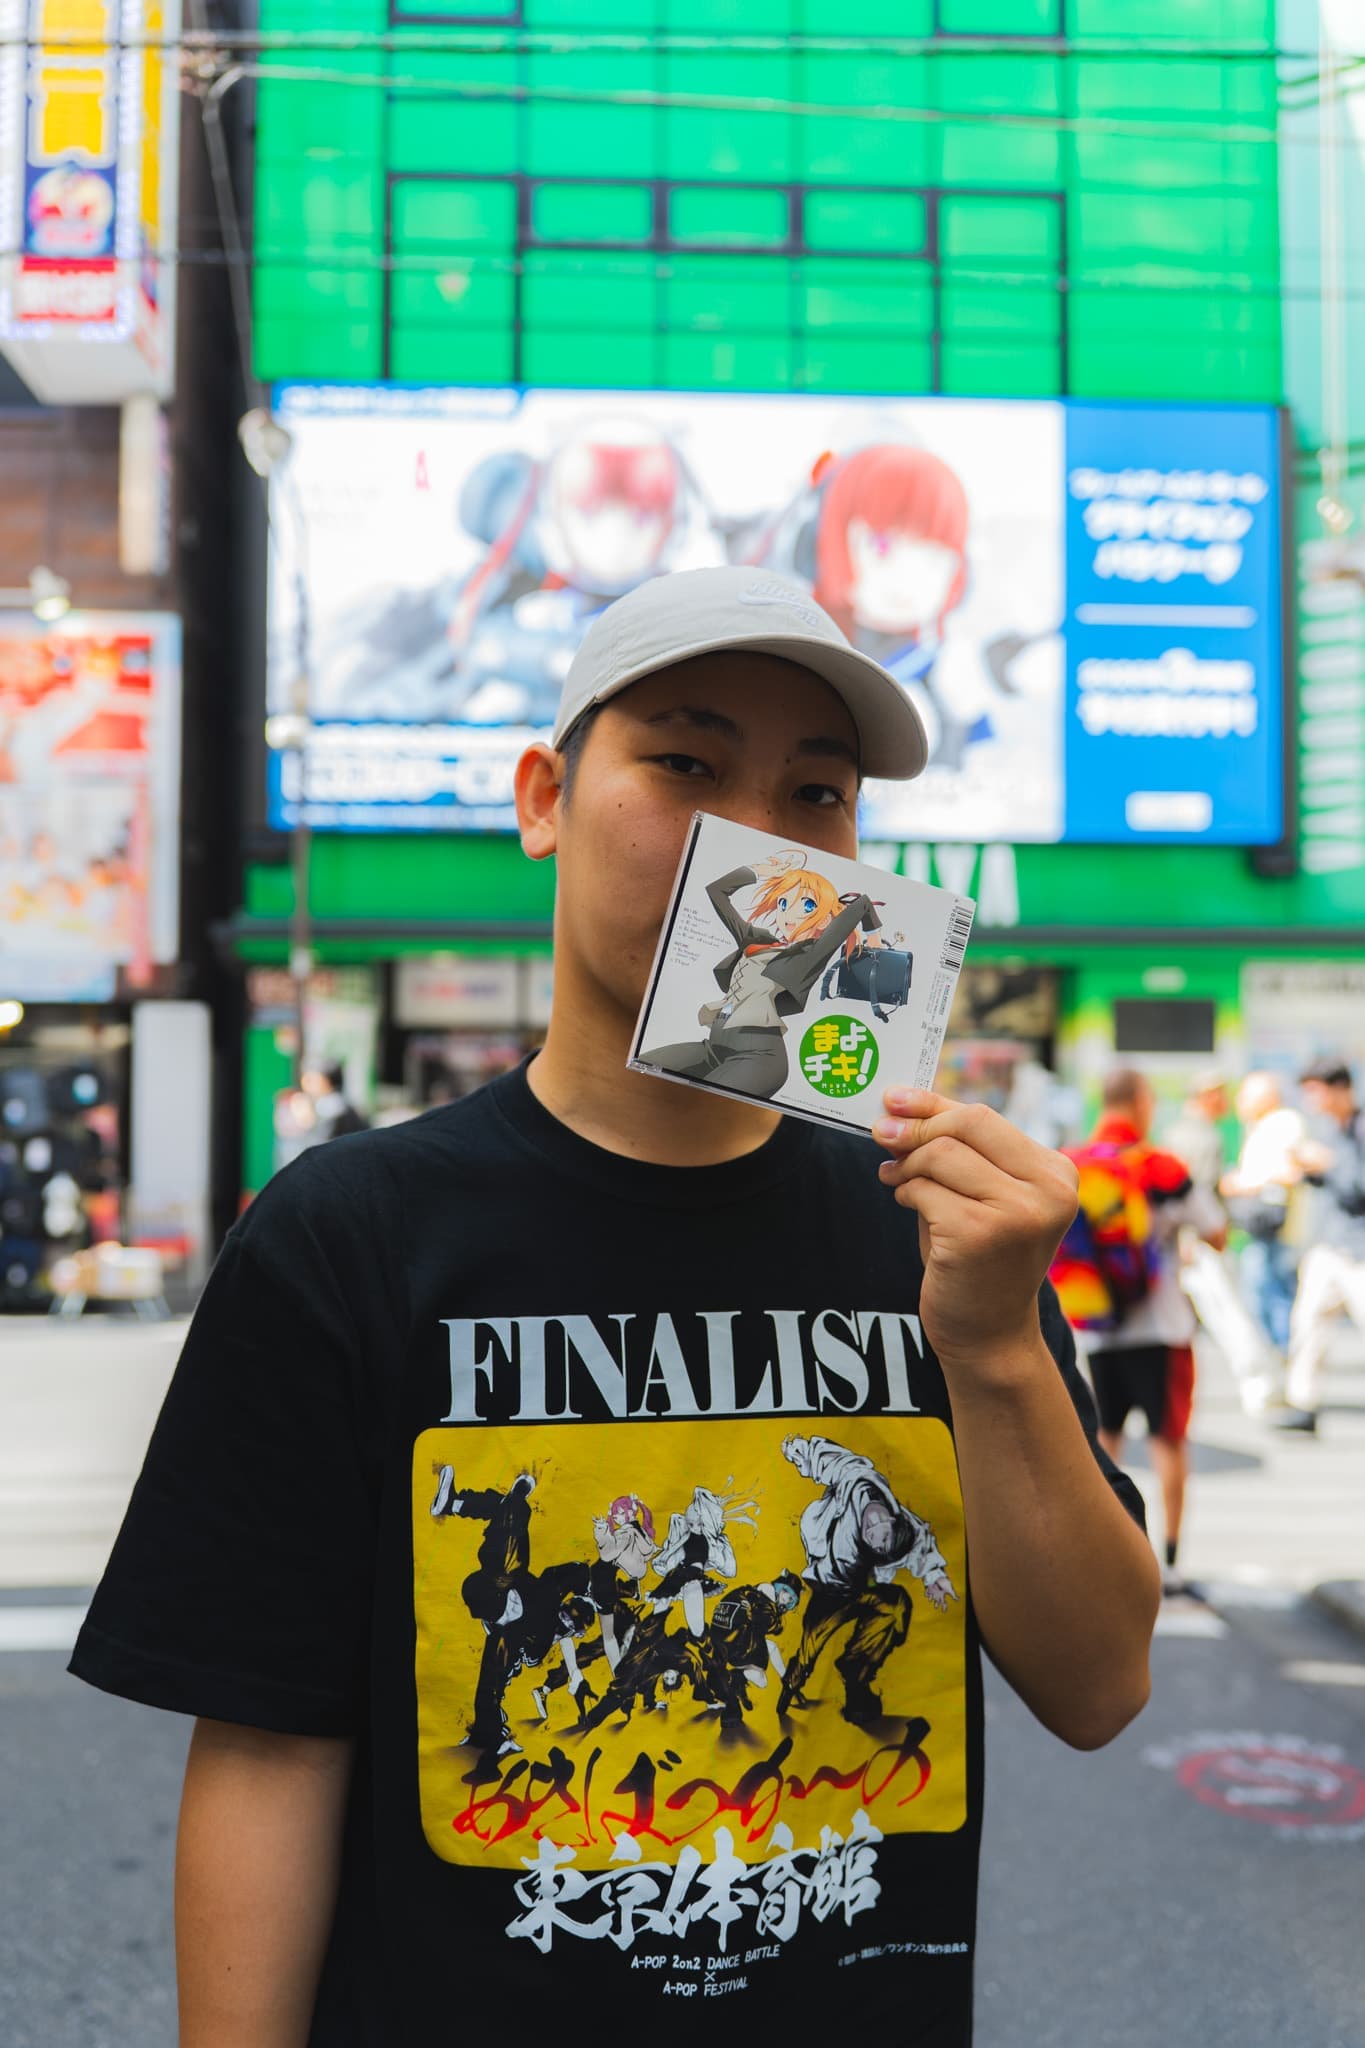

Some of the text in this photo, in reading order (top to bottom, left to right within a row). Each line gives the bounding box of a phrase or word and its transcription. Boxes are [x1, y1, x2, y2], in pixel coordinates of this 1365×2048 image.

[813, 1022, 868, 1052] まよ
[439, 1309, 924, 1422] FINALIST
[505, 1808, 884, 1953] 東京体育館
[631, 1944, 781, 1970] A-POP 2on2 DANCE BATTLE
[663, 1976, 749, 1997] A-POP FESTIVAL
